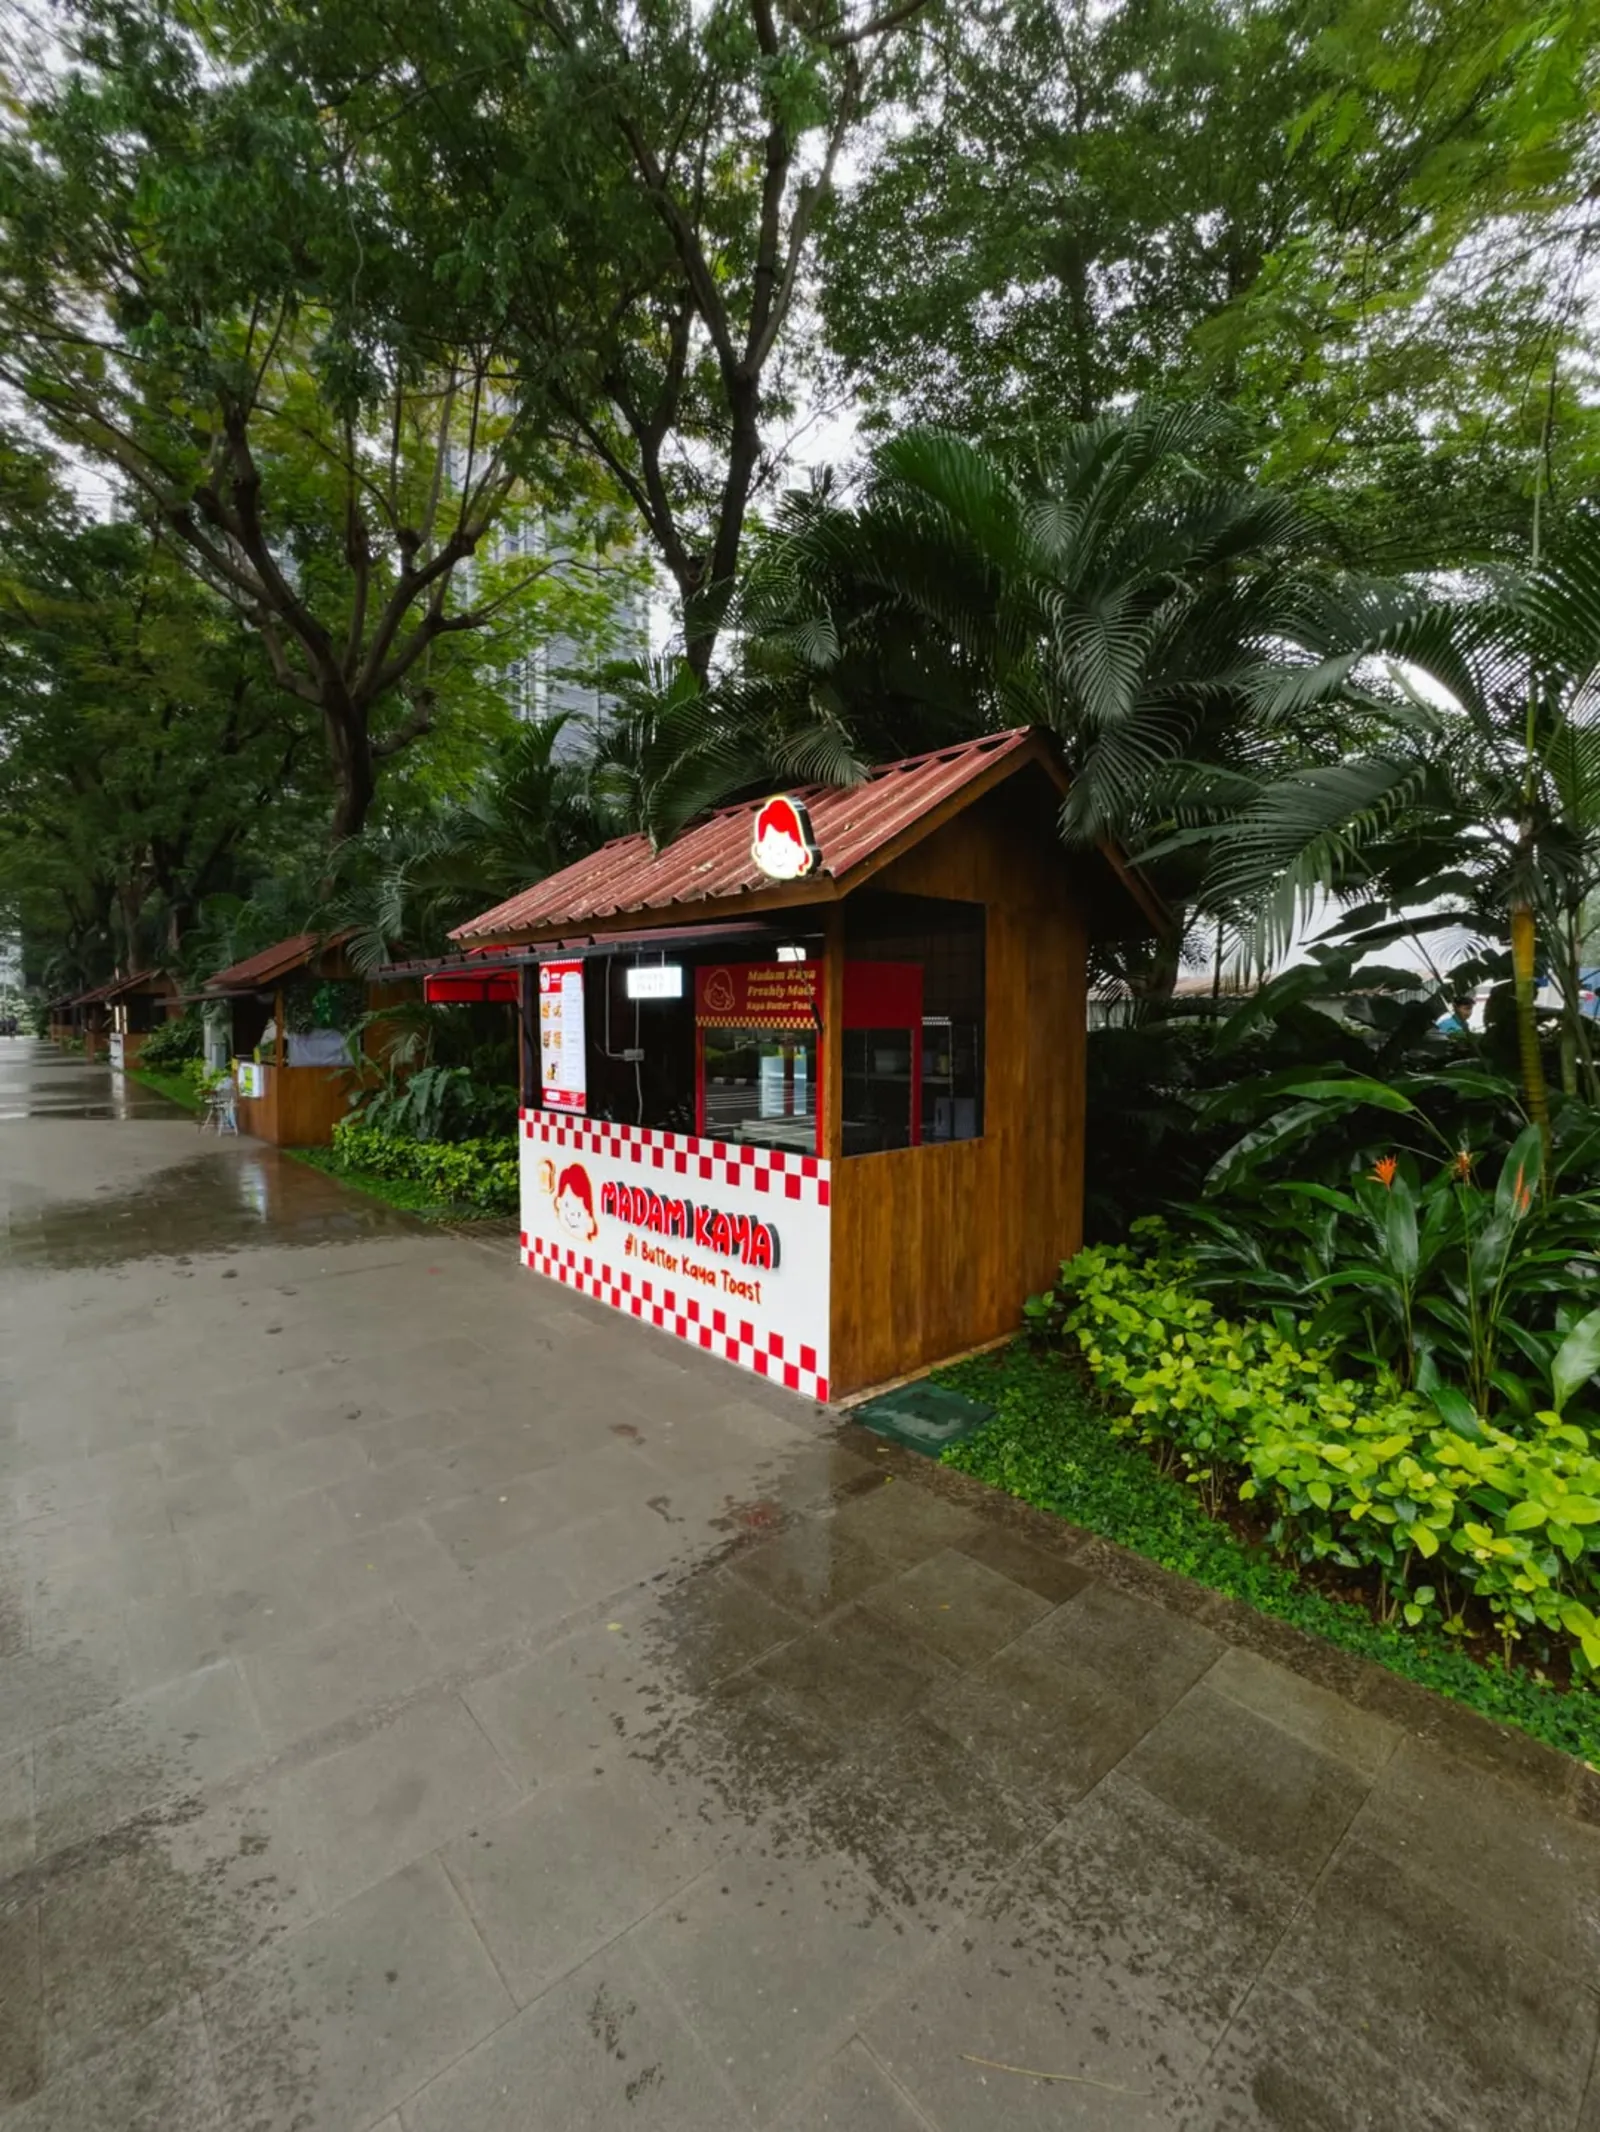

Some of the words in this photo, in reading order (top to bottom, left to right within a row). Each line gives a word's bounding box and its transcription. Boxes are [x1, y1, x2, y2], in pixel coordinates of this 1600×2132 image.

[748, 969, 786, 981] Madam
[787, 968, 816, 981] Kaya
[747, 985, 786, 999] Freshly
[787, 984, 816, 997] Made
[766, 1000, 791, 1011] Butter
[792, 1000, 812, 1011] Toas
[600, 1180, 690, 1240] MADAM
[694, 1204, 776, 1271] KAYA
[624, 1232, 638, 1257] #1
[641, 1239, 679, 1271] Butter
[681, 1253, 717, 1287] Kaya
[720, 1268, 762, 1304] Toast
